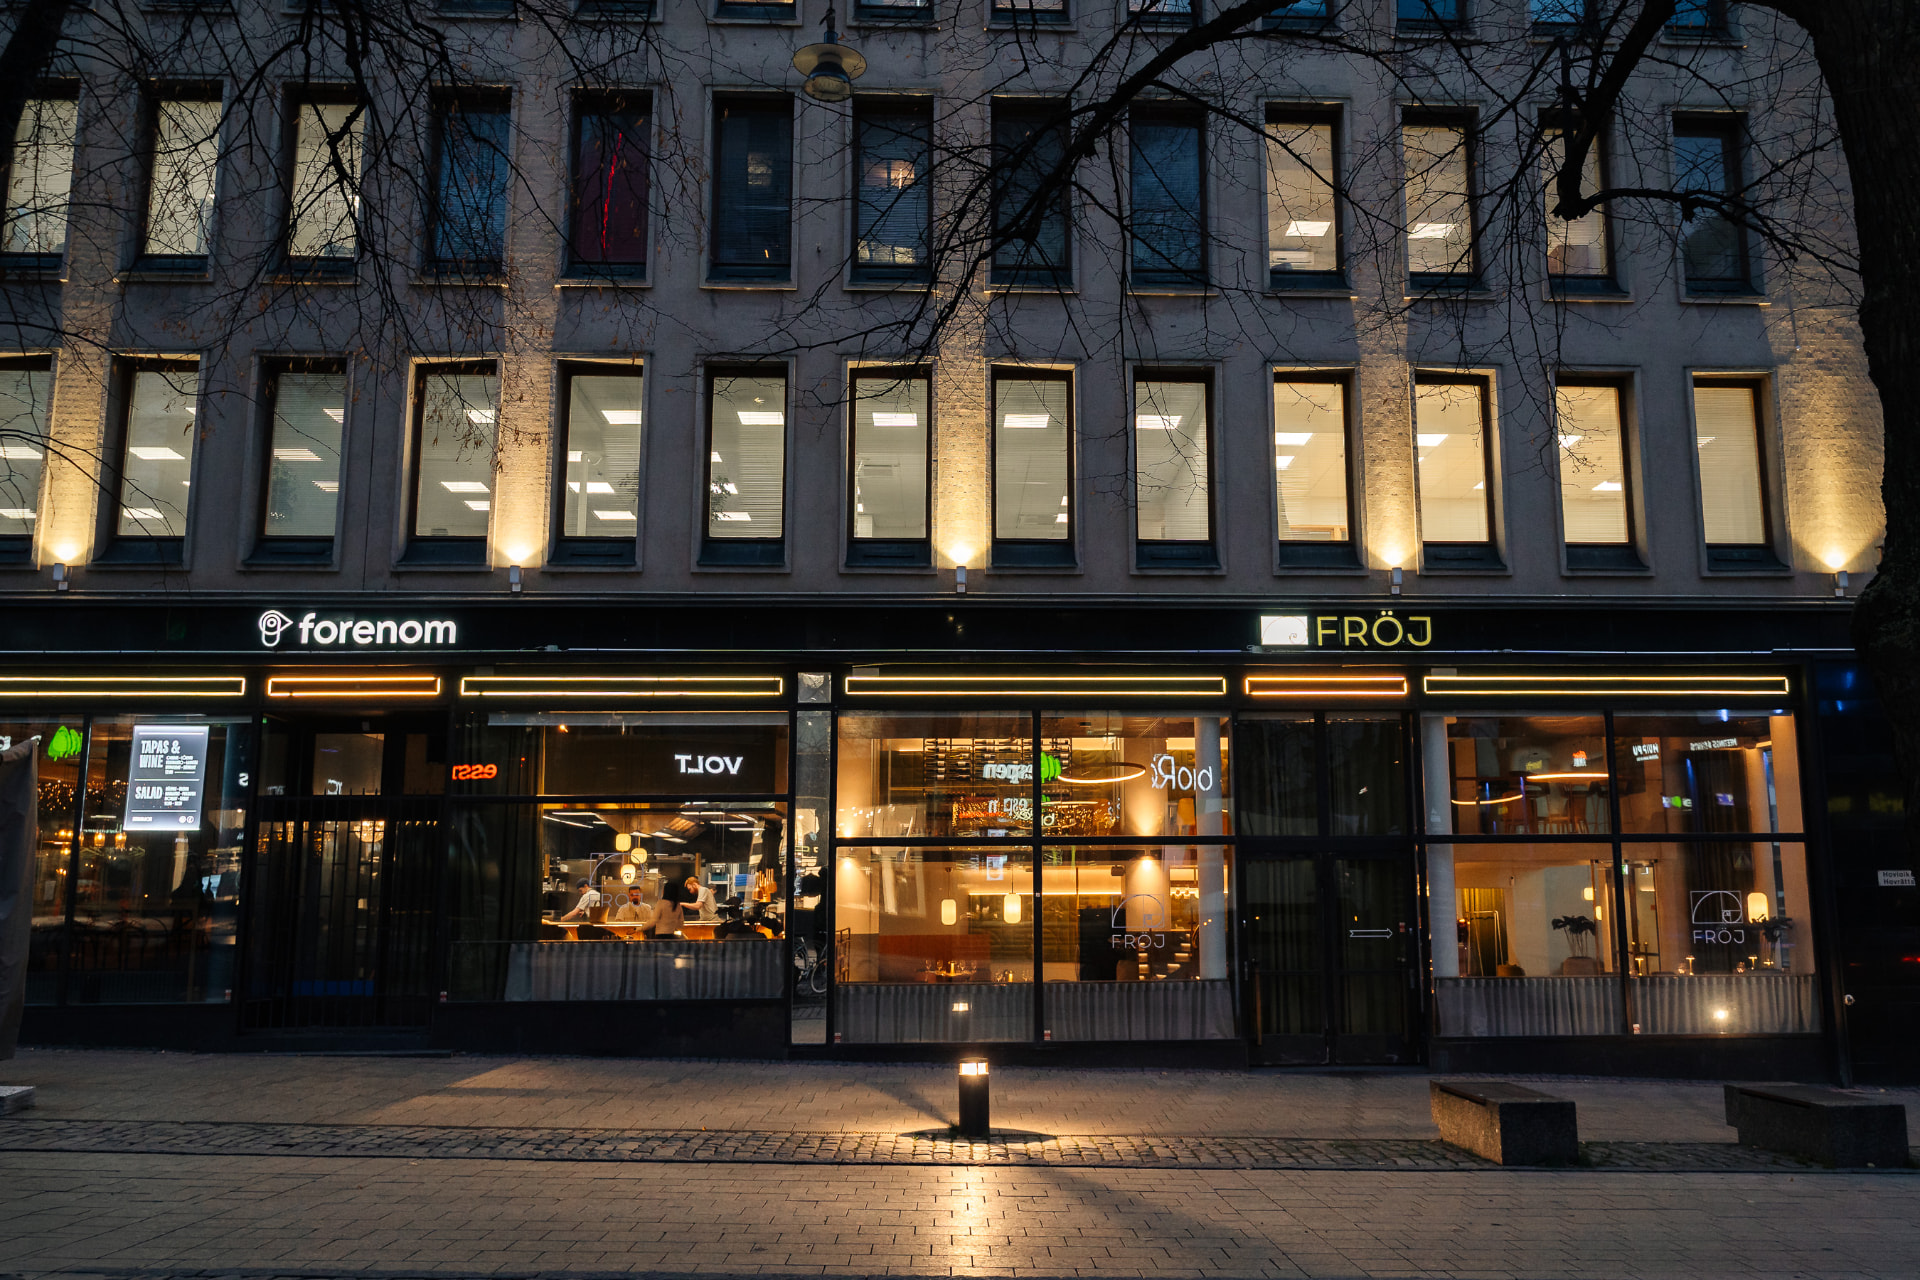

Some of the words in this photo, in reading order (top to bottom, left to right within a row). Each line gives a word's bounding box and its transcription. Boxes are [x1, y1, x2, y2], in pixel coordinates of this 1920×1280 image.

[298, 612, 457, 645] forenom
[1316, 610, 1432, 647] FRÖJ
[141, 739, 170, 754] TAPAS
[171, 740, 181, 754] &
[139, 754, 164, 768] WINE
[135, 786, 163, 799] SALAD
[588, 890, 643, 907] FRÖJ
[1111, 931, 1165, 949] FRÖJ
[1693, 927, 1745, 944] FRÖJ
